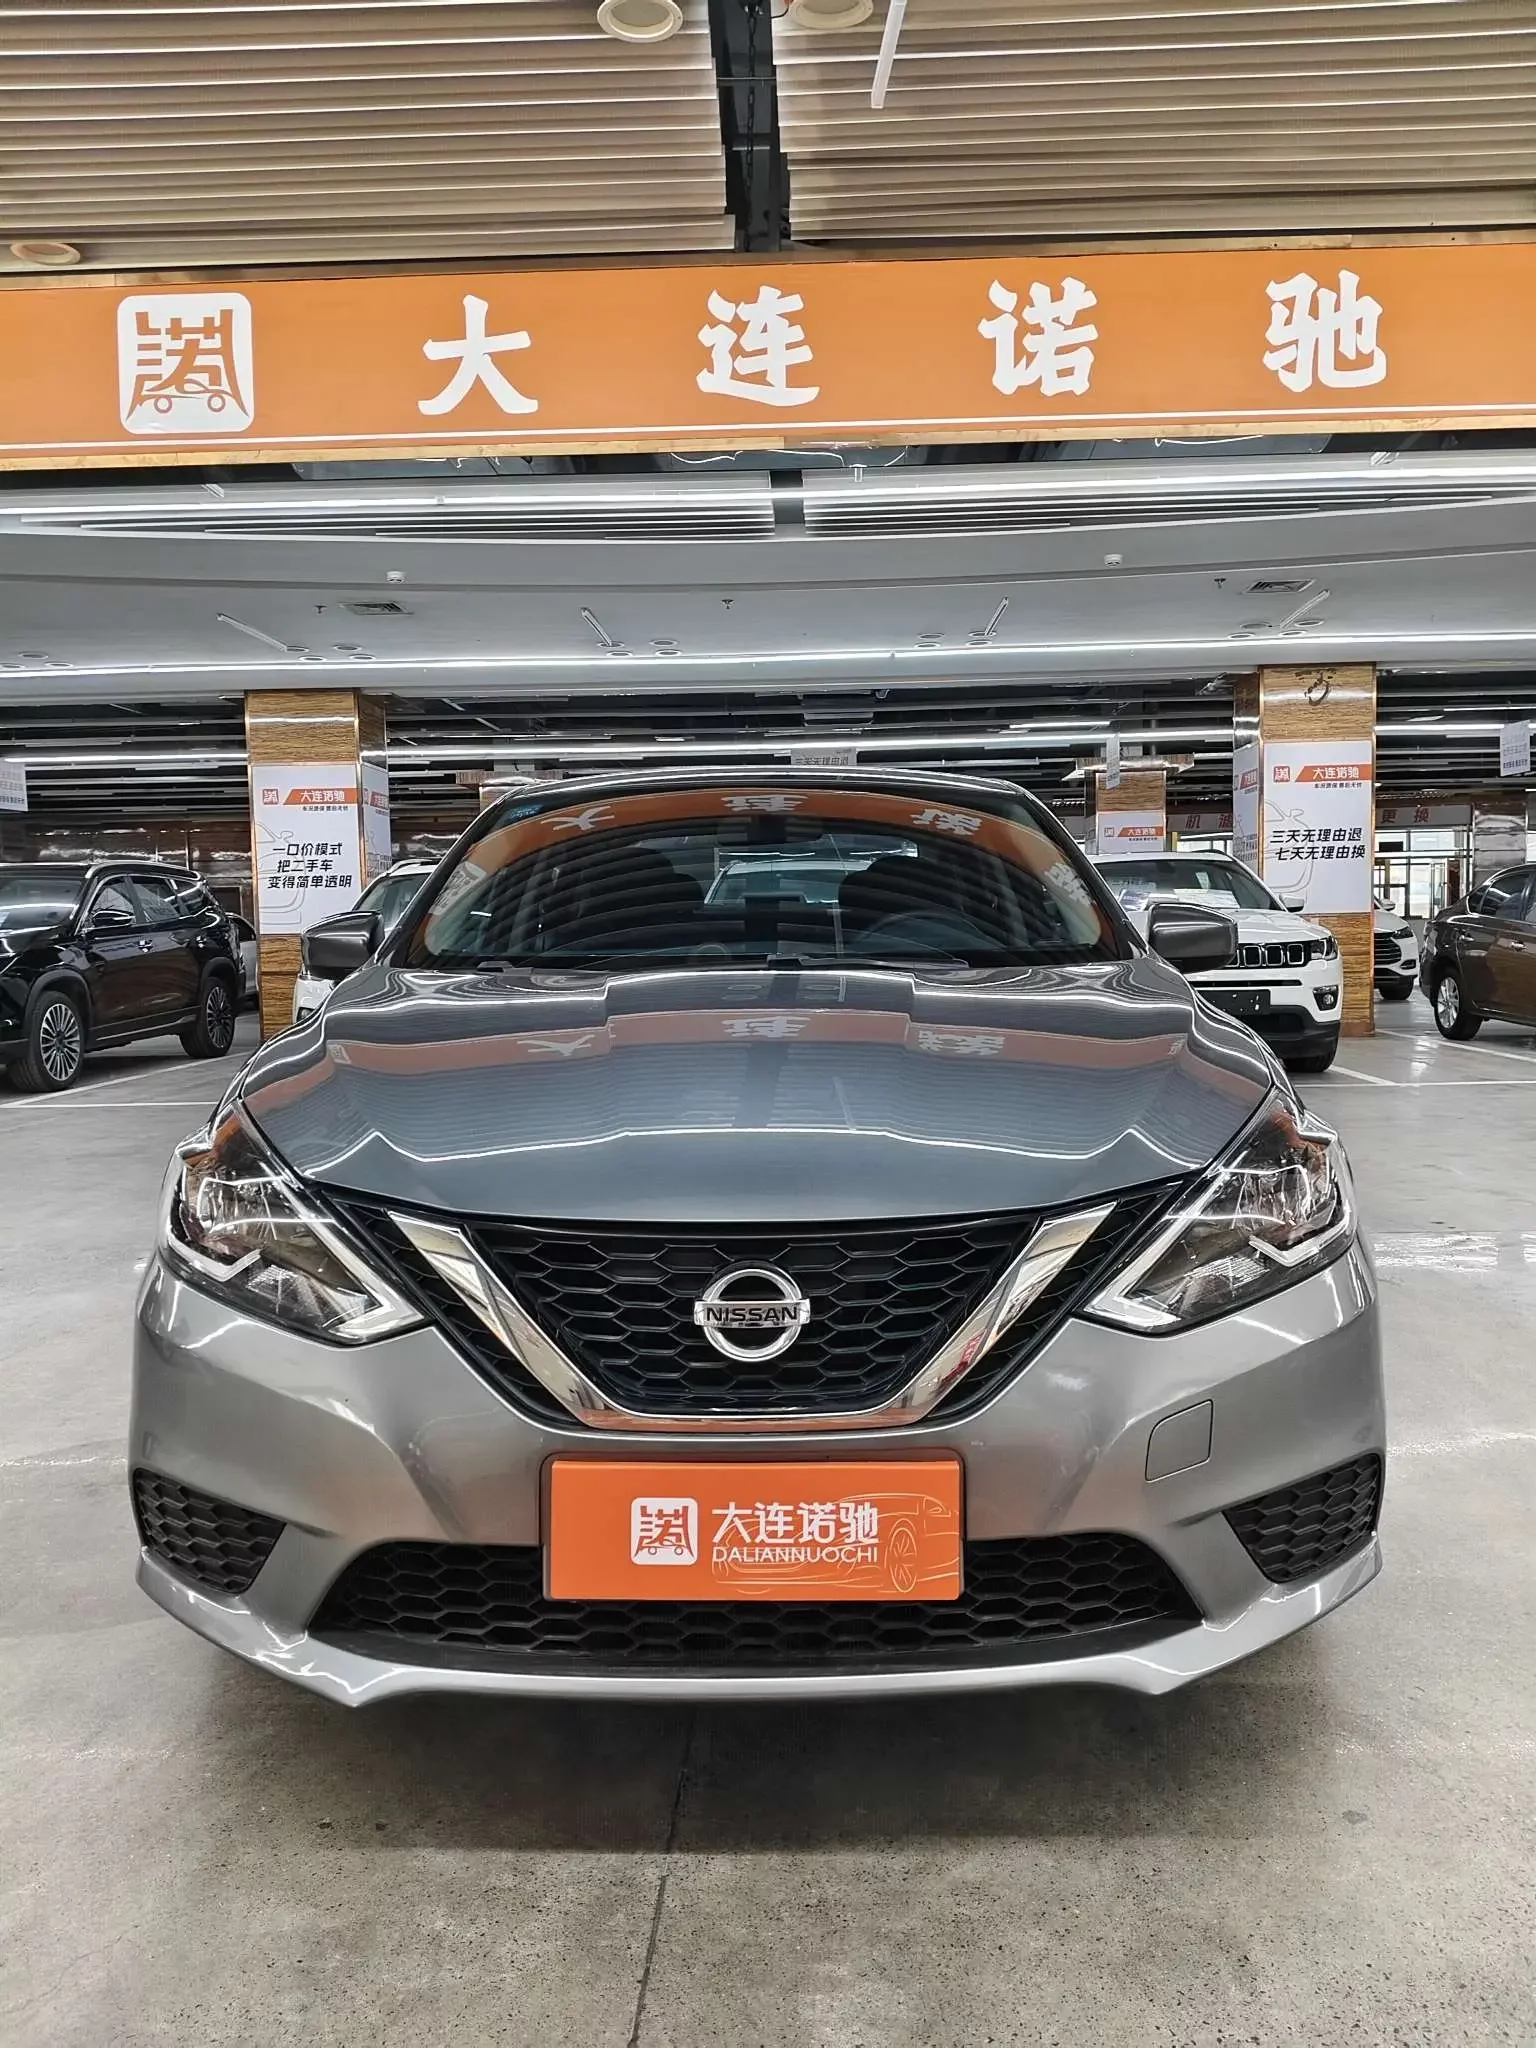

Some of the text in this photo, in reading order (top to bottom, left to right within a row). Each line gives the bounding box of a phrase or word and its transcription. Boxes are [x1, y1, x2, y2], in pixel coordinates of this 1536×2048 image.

[417, 268, 1387, 416] 大连诺驰
[1313, 766, 1359, 779] 大连诺驰
[300, 790, 345, 803] 大连诺驰
[1380, 808, 1429, 824] 更换
[1270, 827, 1363, 843] 三天无理由退
[273, 842, 343, 856] 一口价模式
[1275, 845, 1366, 861] 七天无理由换
[277, 859, 333, 873] 把二手车
[267, 875, 353, 889] 变得简单透明
[706, 1306, 798, 1322] NISSAN
[711, 1501, 880, 1545] 大连诺驰
[712, 1546, 878, 1564] DALIANNUOCHI
